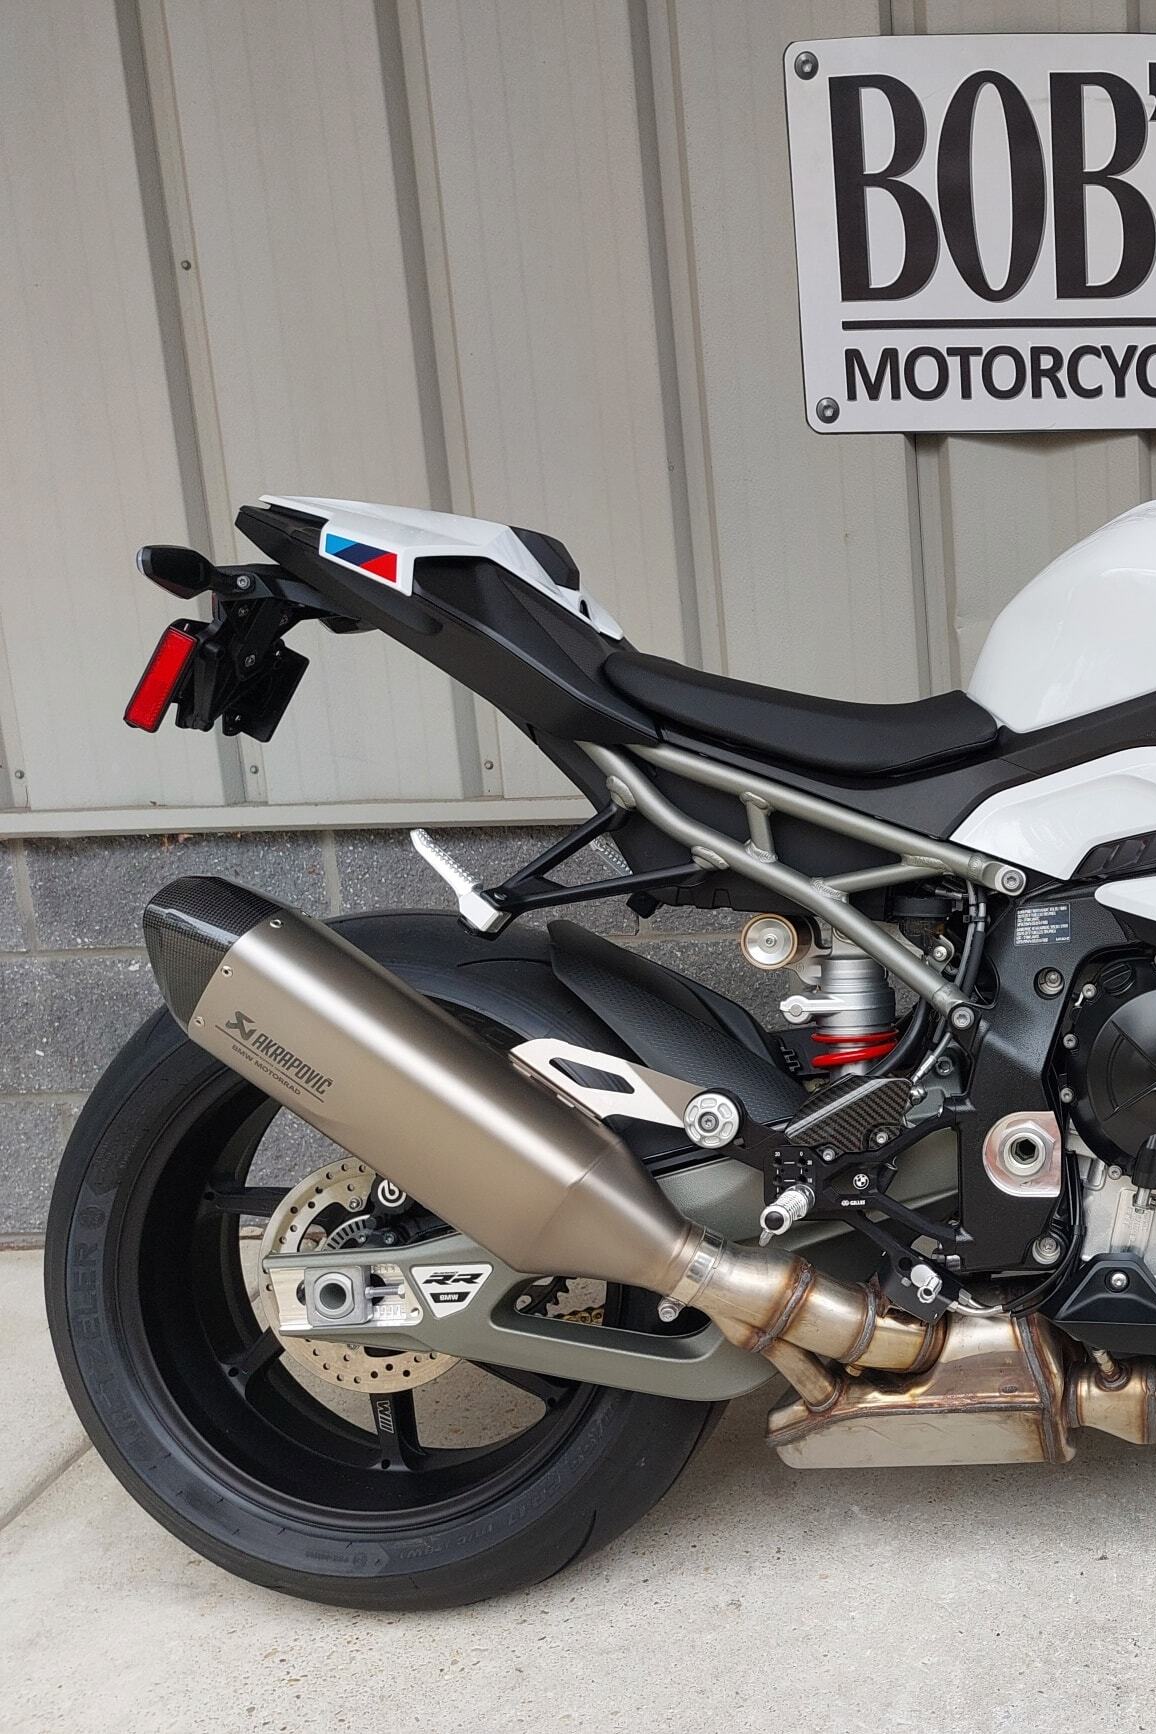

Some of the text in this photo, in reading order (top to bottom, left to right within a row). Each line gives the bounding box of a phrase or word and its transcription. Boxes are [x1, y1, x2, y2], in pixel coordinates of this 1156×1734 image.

[231, 1043, 301, 1096] BMW MOTORRAD
[422, 1272, 484, 1286] RR
[439, 1293, 459, 1301] BMW
